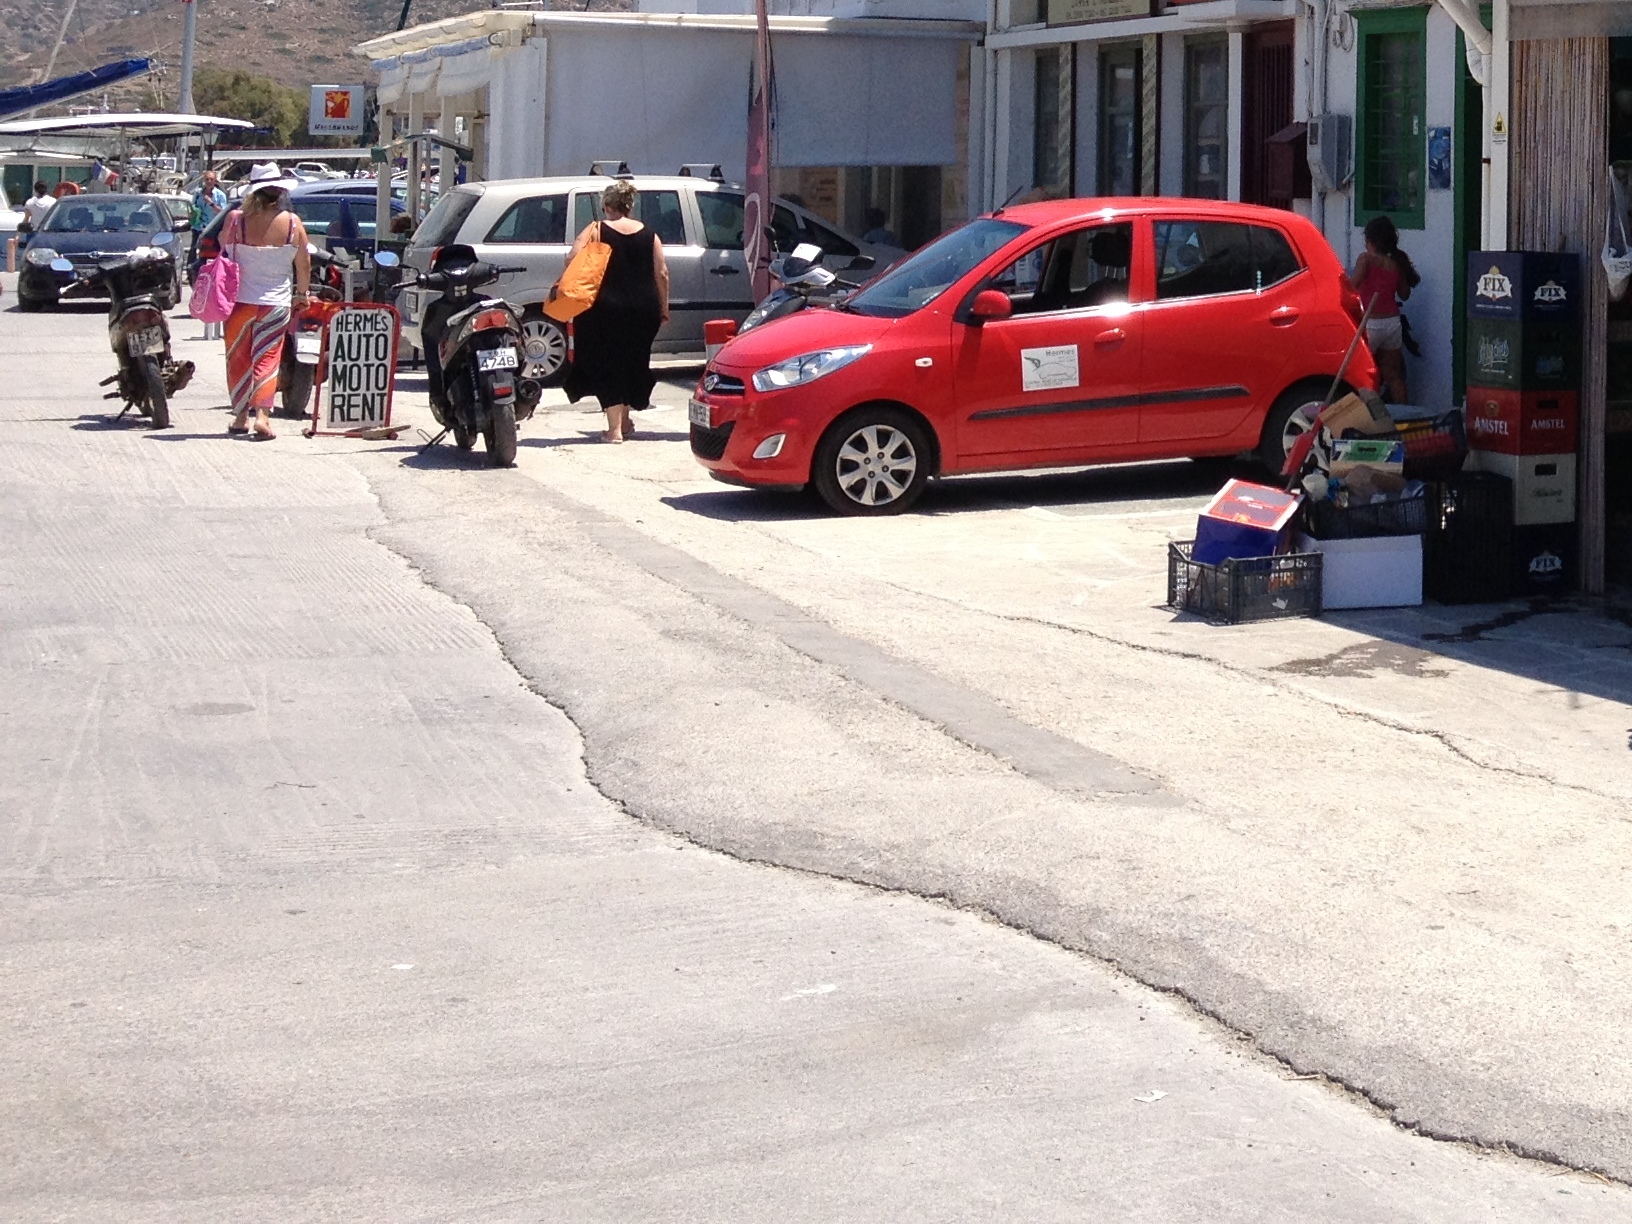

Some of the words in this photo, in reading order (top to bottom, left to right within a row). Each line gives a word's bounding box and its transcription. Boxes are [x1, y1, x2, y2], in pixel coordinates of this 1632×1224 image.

[1483, 276, 1506, 293] FIX
[1541, 287, 1562, 297] FIX
[336, 313, 389, 332] HERMES
[333, 333, 389, 363] AUTO
[481, 355, 516, 369] 4748
[332, 362, 389, 393] MOTO
[330, 392, 388, 423] RENT
[1474, 416, 1509, 436] AMSTEL
[1531, 418, 1565, 430] AMSTEL
